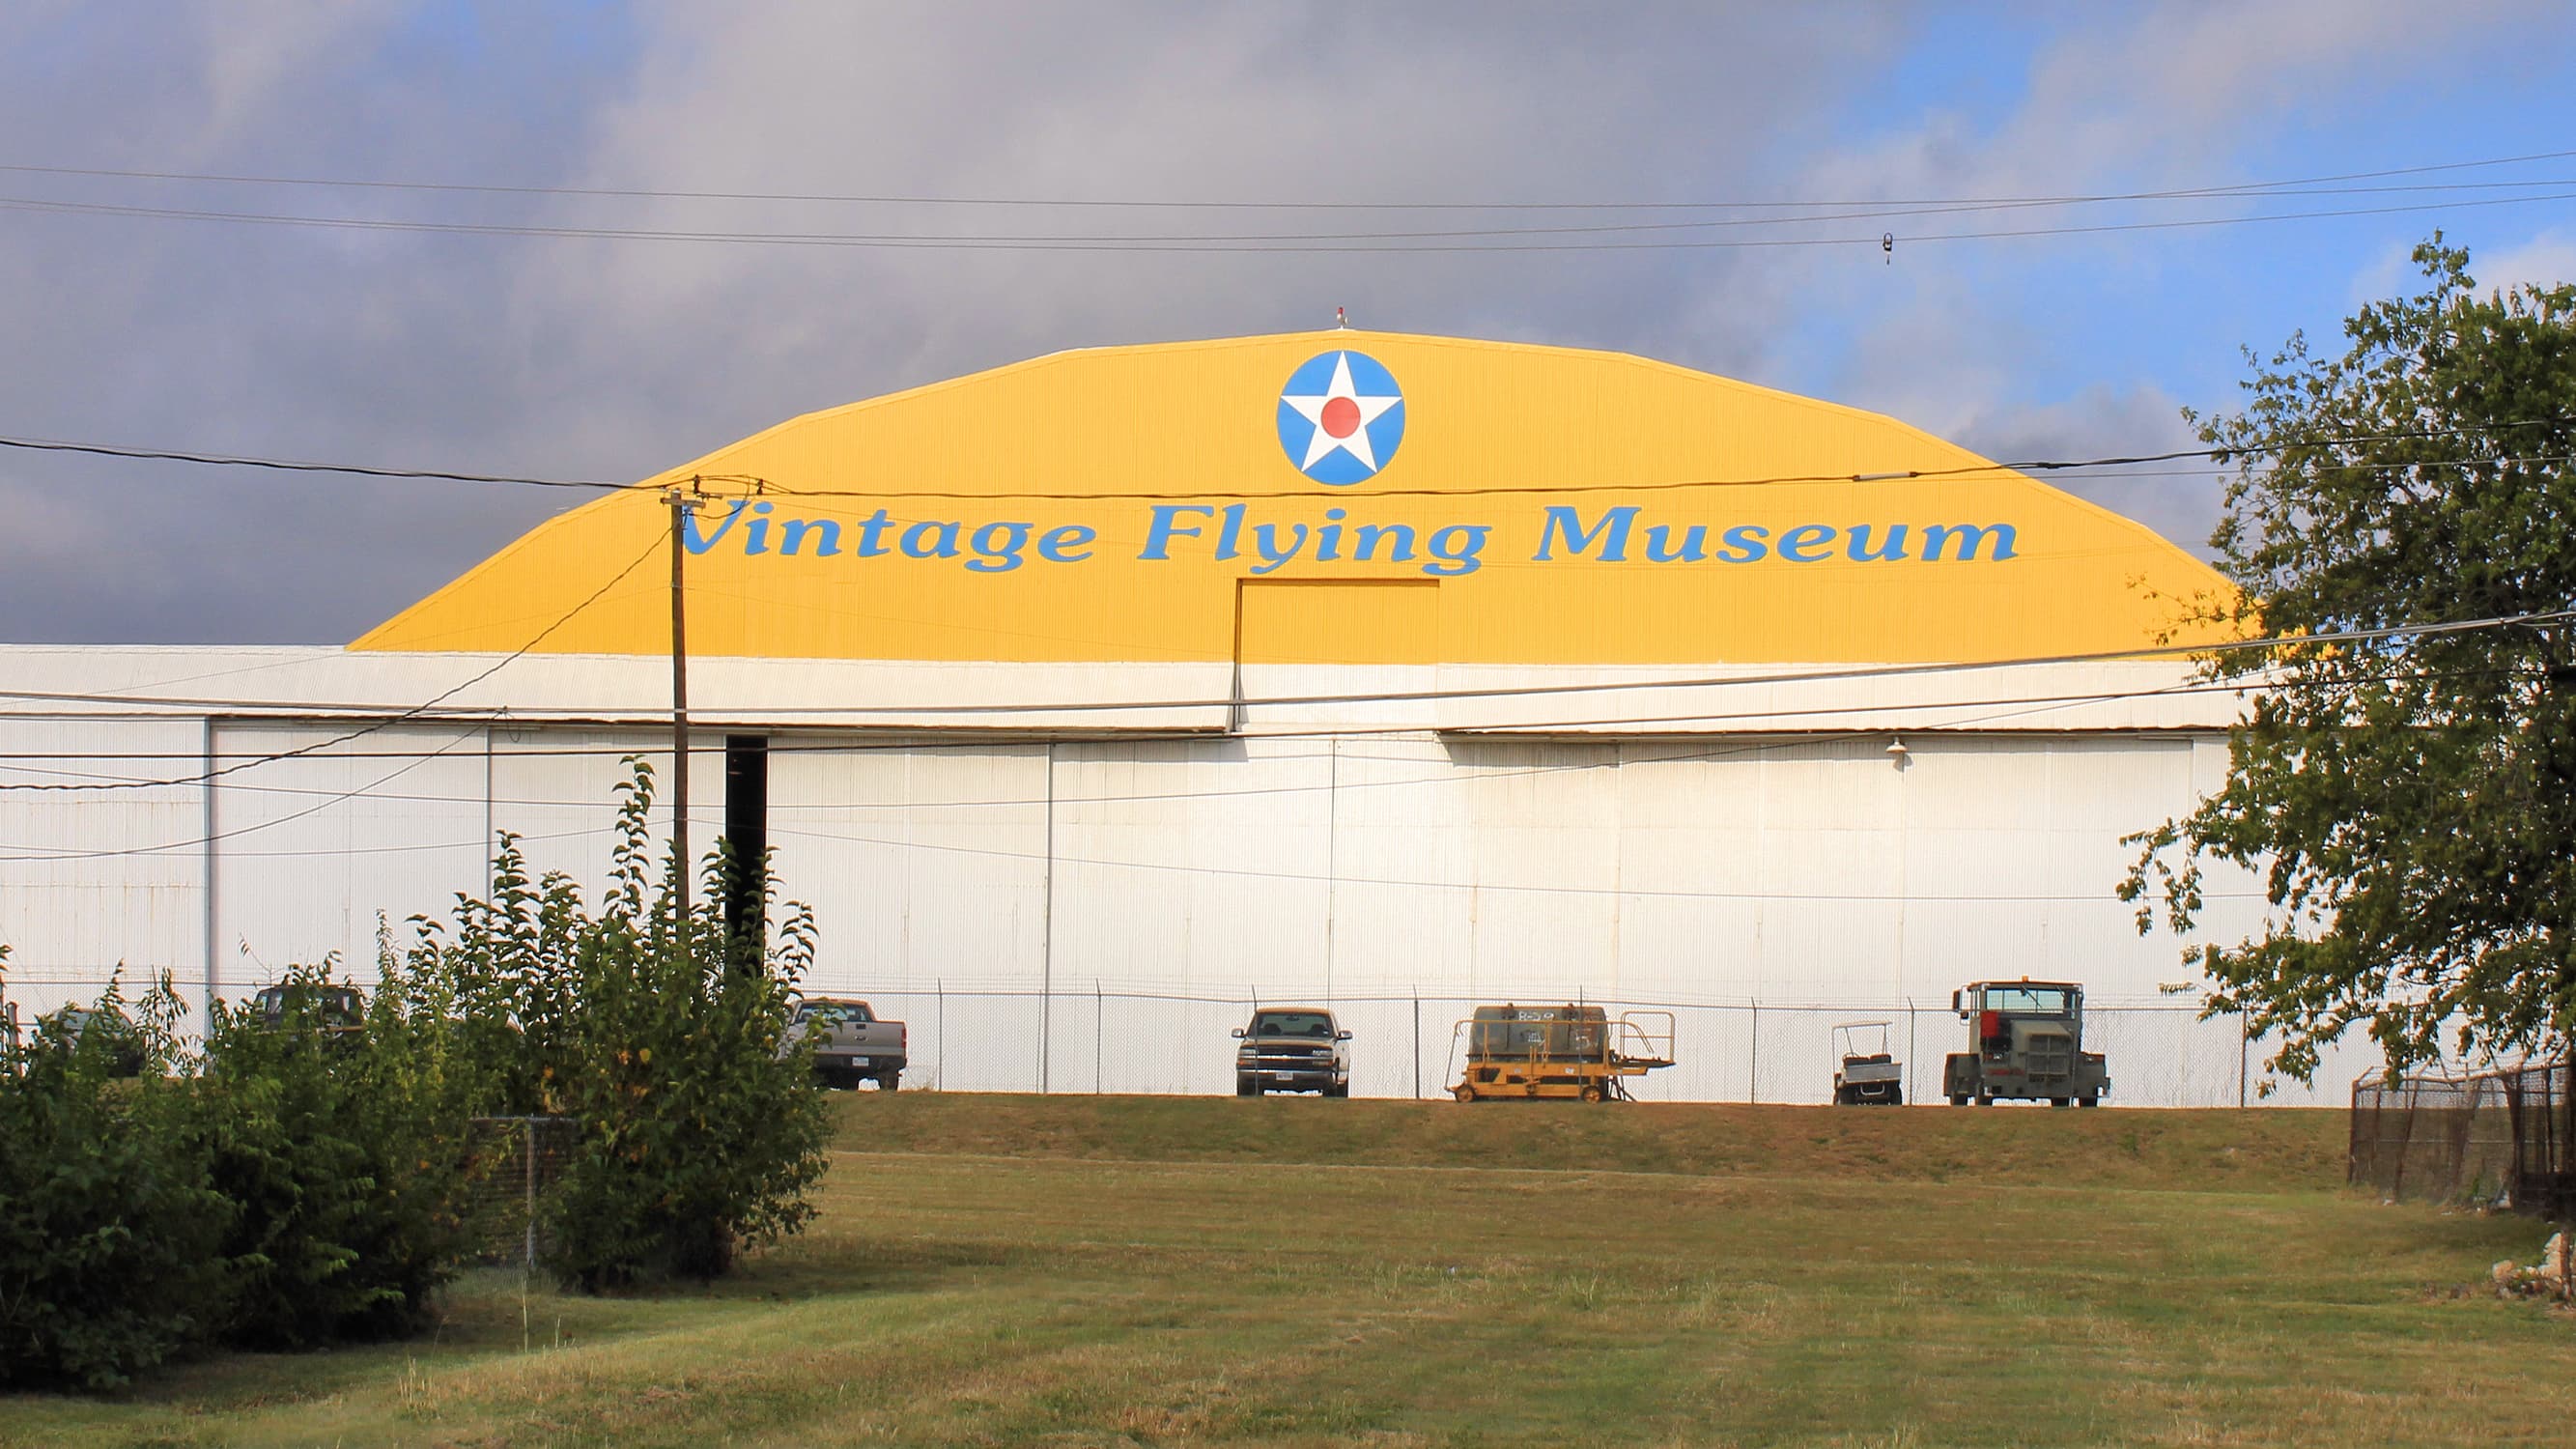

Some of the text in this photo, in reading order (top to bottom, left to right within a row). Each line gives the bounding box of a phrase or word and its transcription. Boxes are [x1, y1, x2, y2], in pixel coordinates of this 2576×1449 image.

[682, 499, 2019, 575] Vintage Flying Museum
